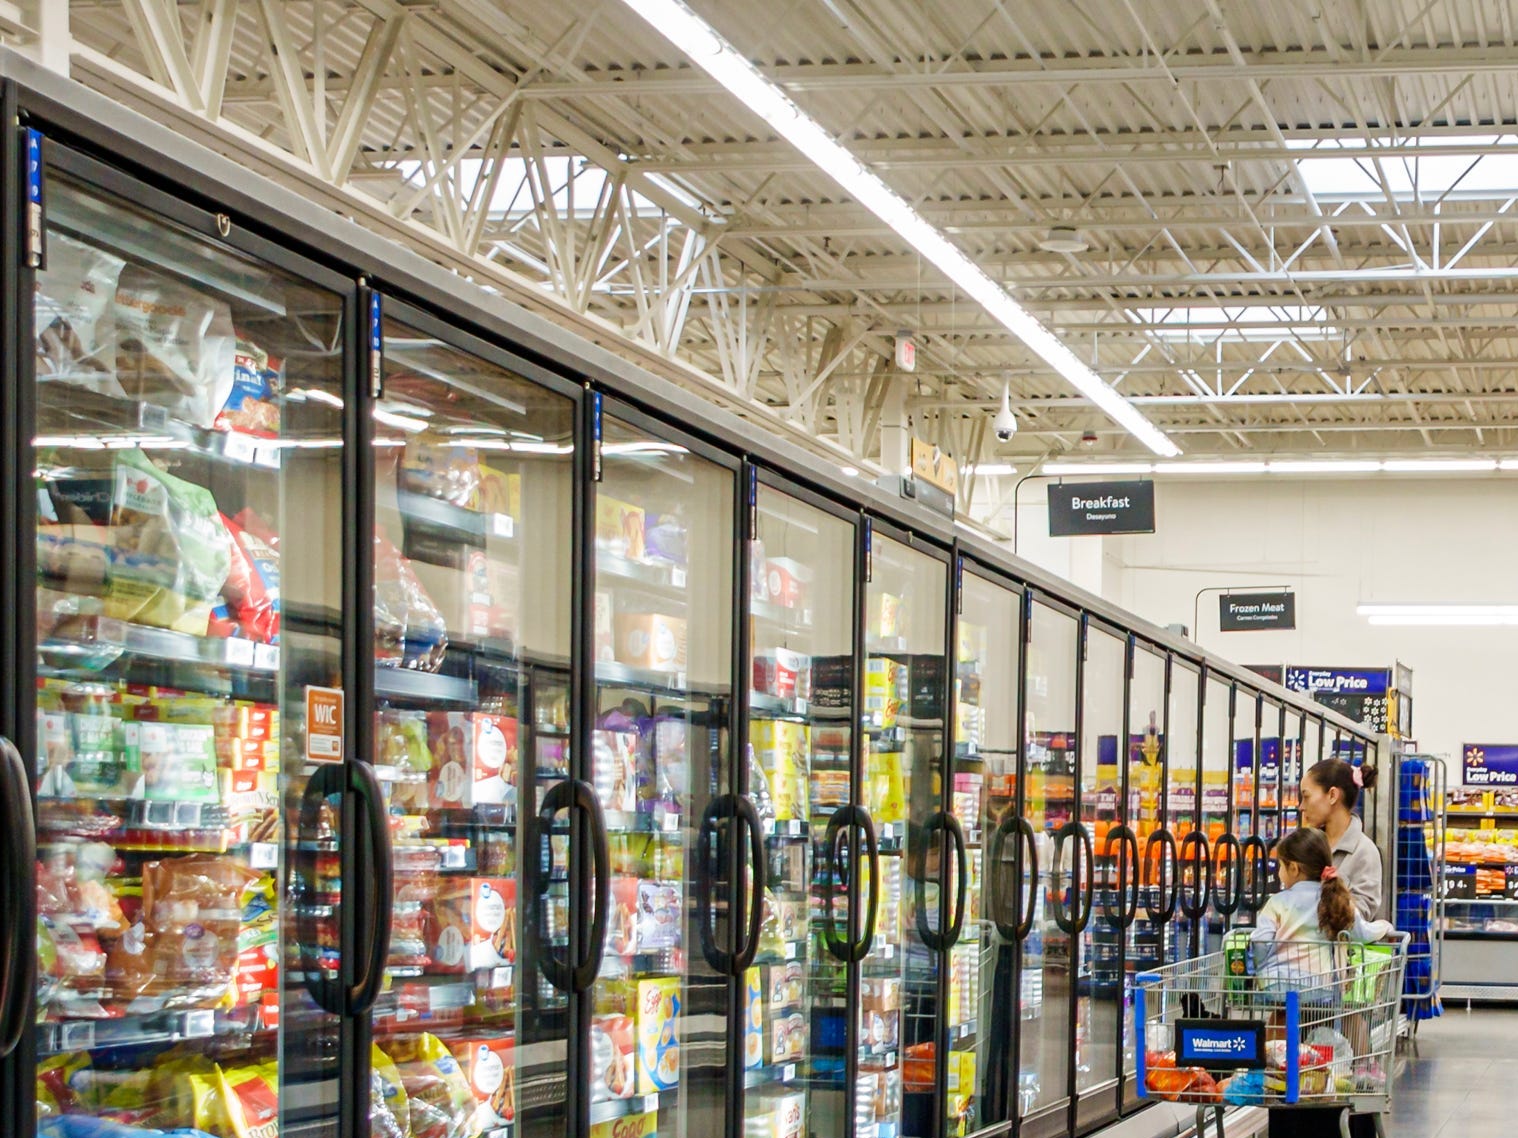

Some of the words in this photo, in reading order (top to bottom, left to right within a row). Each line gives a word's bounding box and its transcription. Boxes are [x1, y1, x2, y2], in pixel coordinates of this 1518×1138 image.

[1071, 496, 1130, 511] Breakfast
[1229, 603, 1260, 614] Frozen
[1261, 602, 1285, 613] Meat
[1308, 676, 1335, 688] Low
[1336, 677, 1368, 689] Price
[314, 703, 337, 725] WIC
[1466, 771, 1489, 782] Low
[1489, 771, 1517, 782] Price
[1192, 1037, 1232, 1048] Walmart
